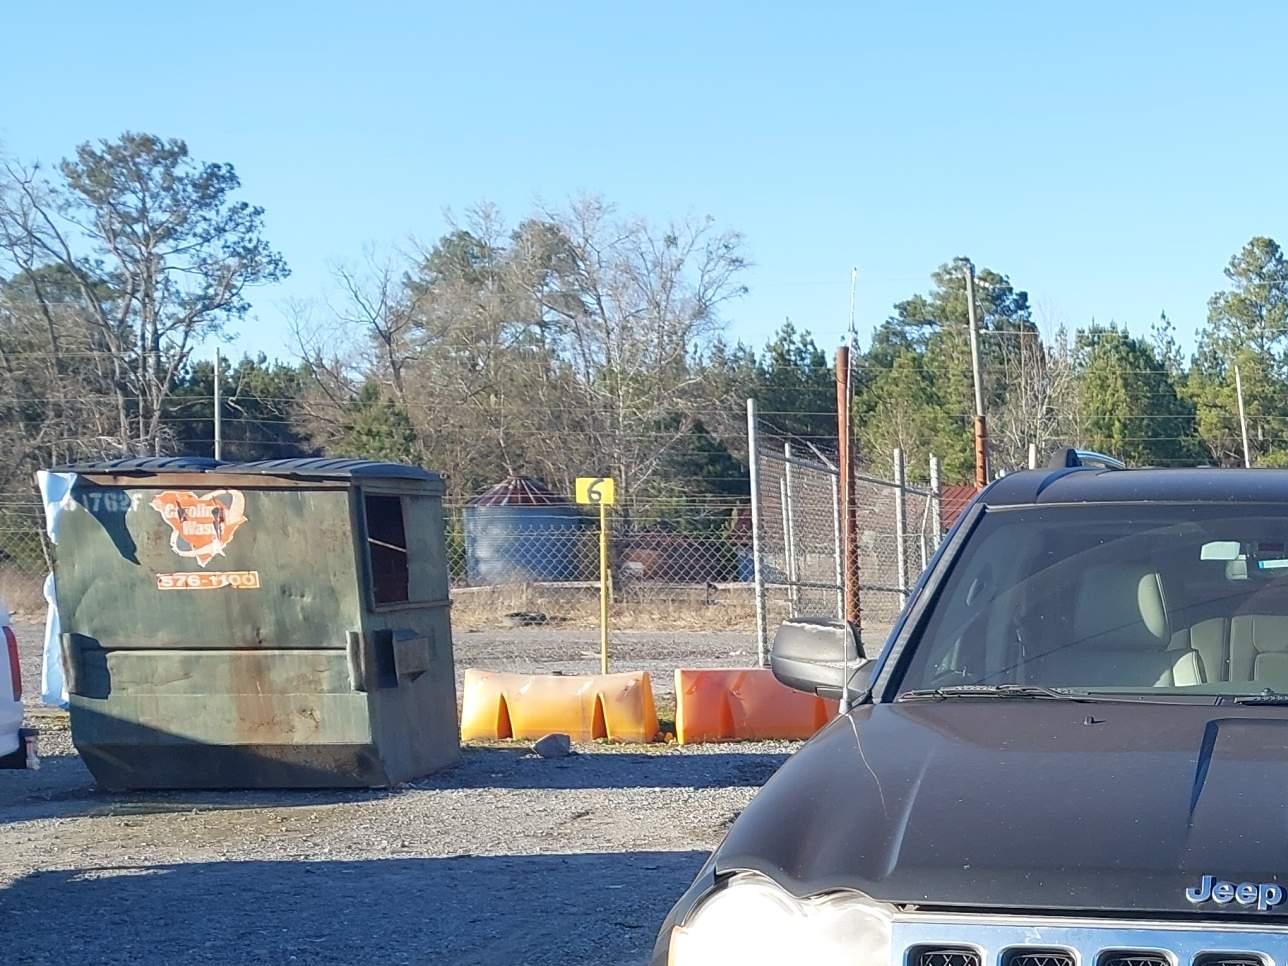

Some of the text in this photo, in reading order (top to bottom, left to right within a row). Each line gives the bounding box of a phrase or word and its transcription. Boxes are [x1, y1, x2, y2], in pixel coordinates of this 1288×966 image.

[587, 478, 605, 503] 6
[183, 520, 225, 536] Wast
[1185, 874, 1284, 911] Jeep
